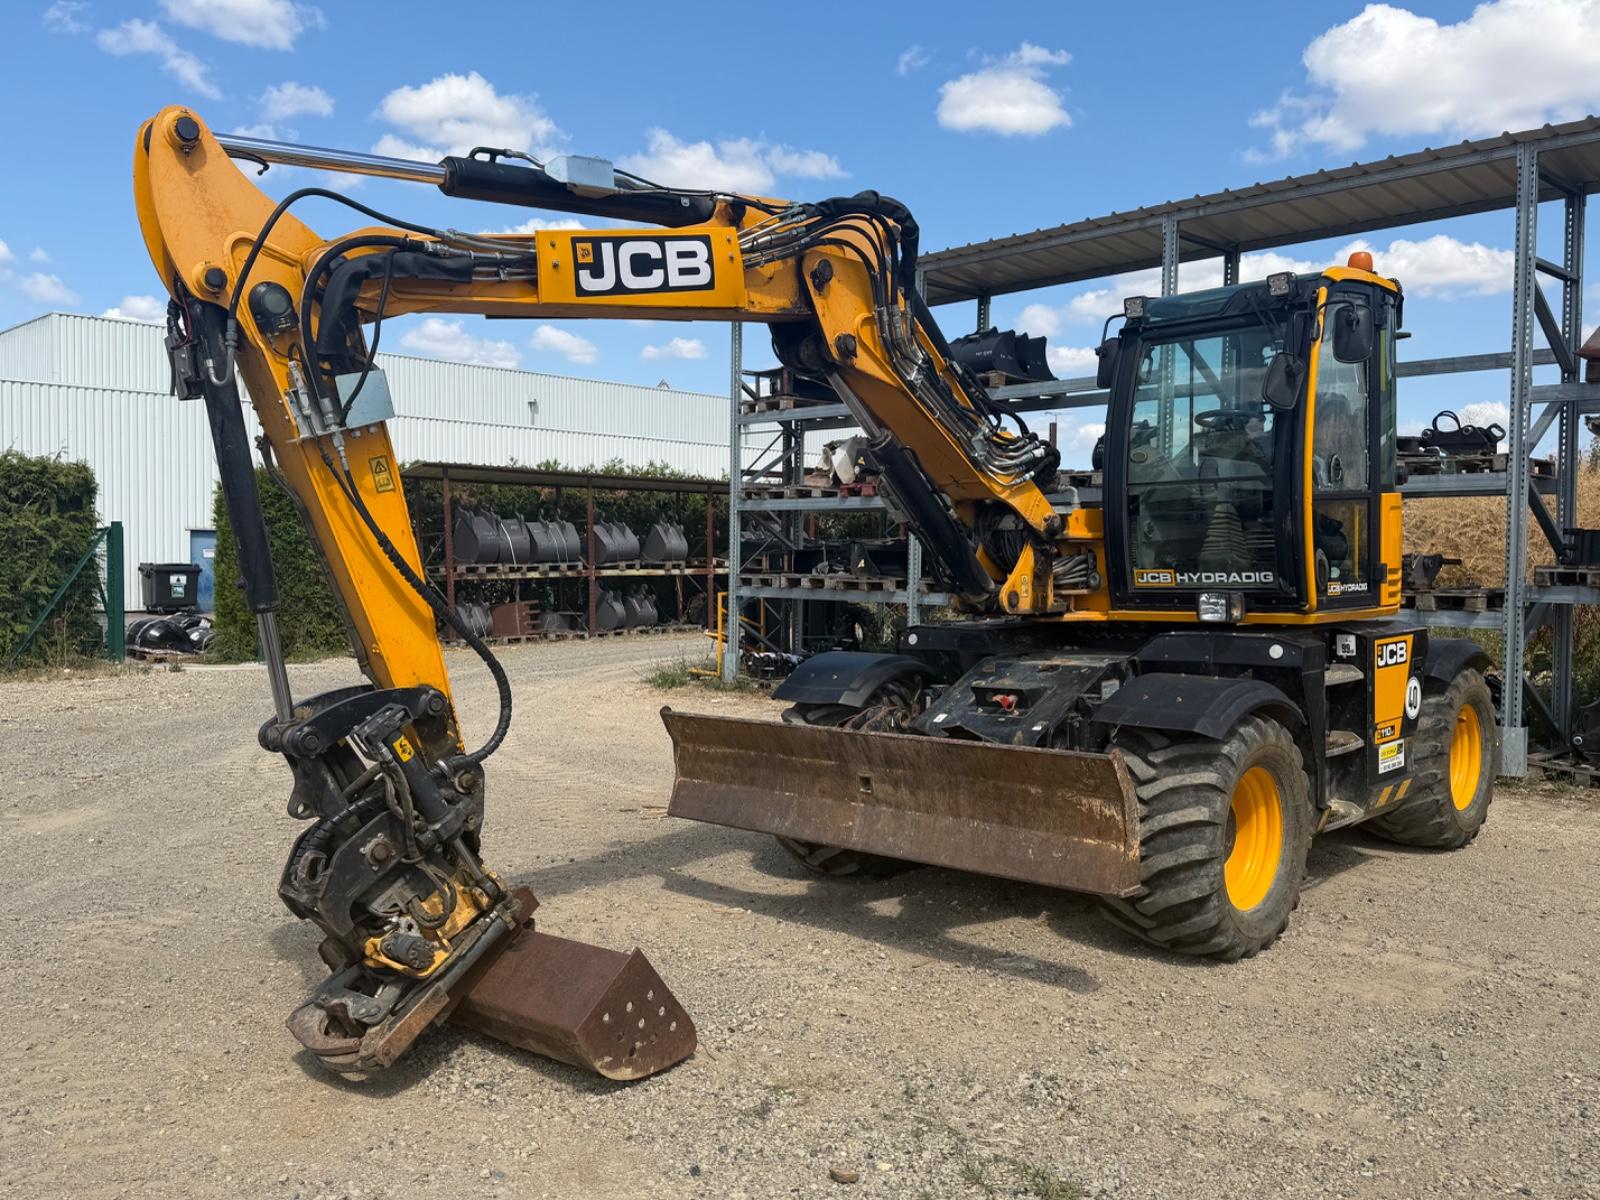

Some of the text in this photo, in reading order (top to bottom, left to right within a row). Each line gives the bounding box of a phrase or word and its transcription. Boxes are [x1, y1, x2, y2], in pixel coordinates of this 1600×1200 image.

[578, 240, 712, 292] JCB
[1137, 571, 1274, 584] JCB HYDRADIG
[1377, 641, 1407, 667] JCB
[1408, 685, 1418, 711] 40
